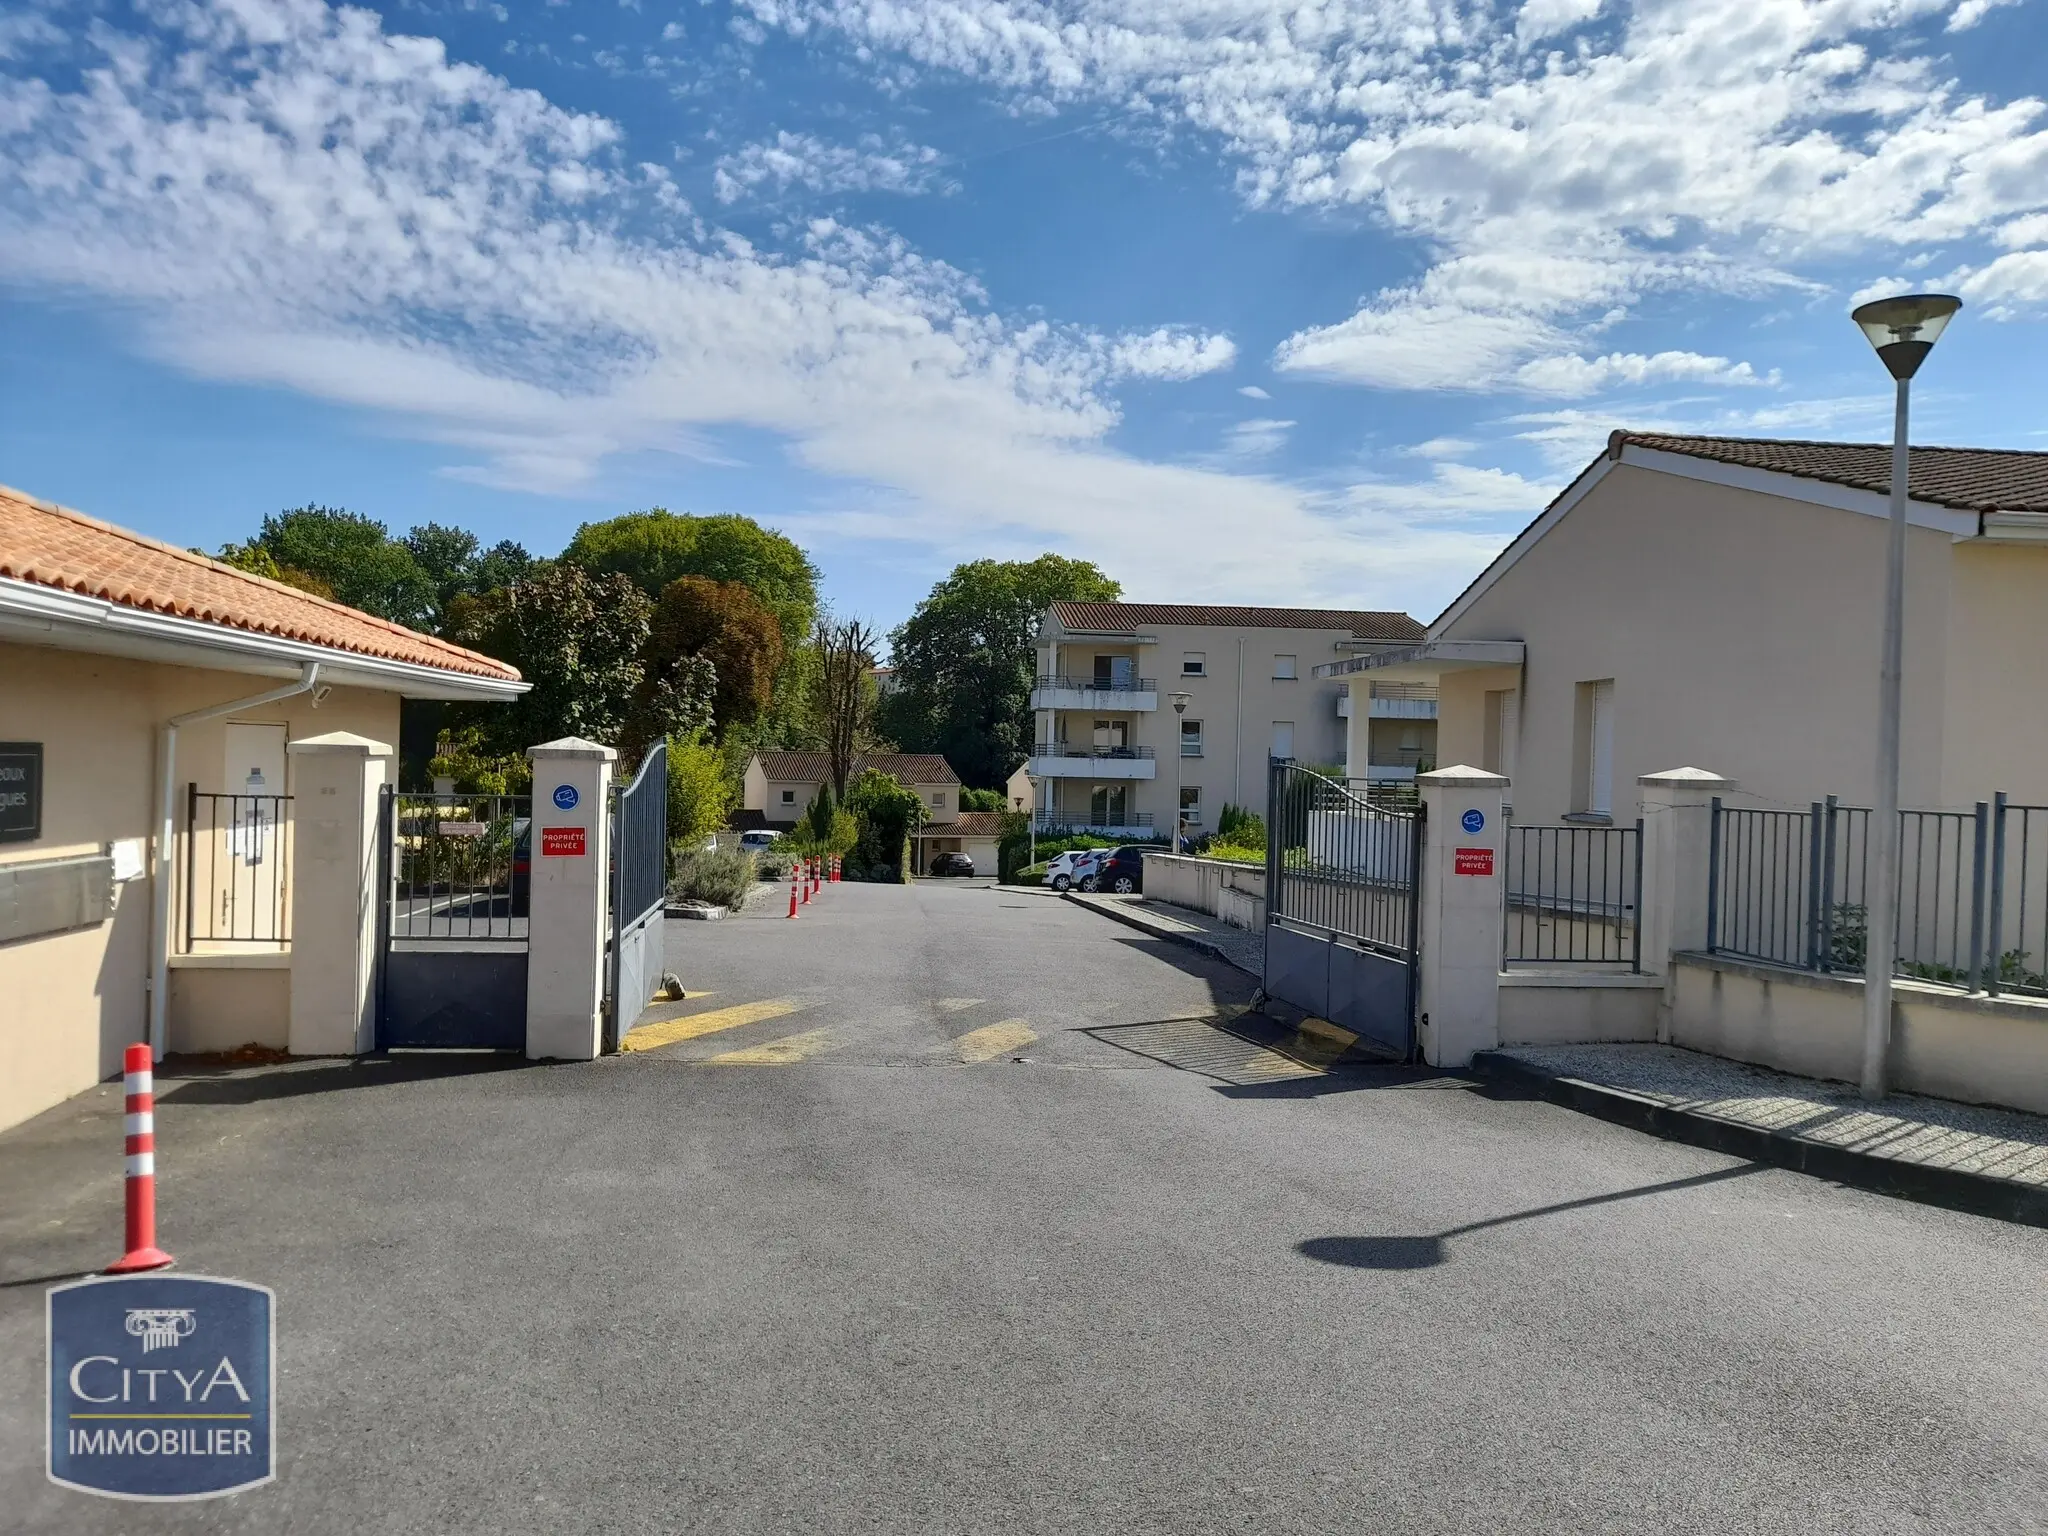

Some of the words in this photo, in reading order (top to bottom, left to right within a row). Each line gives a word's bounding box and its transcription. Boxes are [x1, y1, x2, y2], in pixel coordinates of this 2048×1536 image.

[543, 833, 585, 841] PROPRIÉTÉ
[550, 841, 578, 849] PRIVÉE
[1455, 854, 1493, 862] PROPRIÉTÉ
